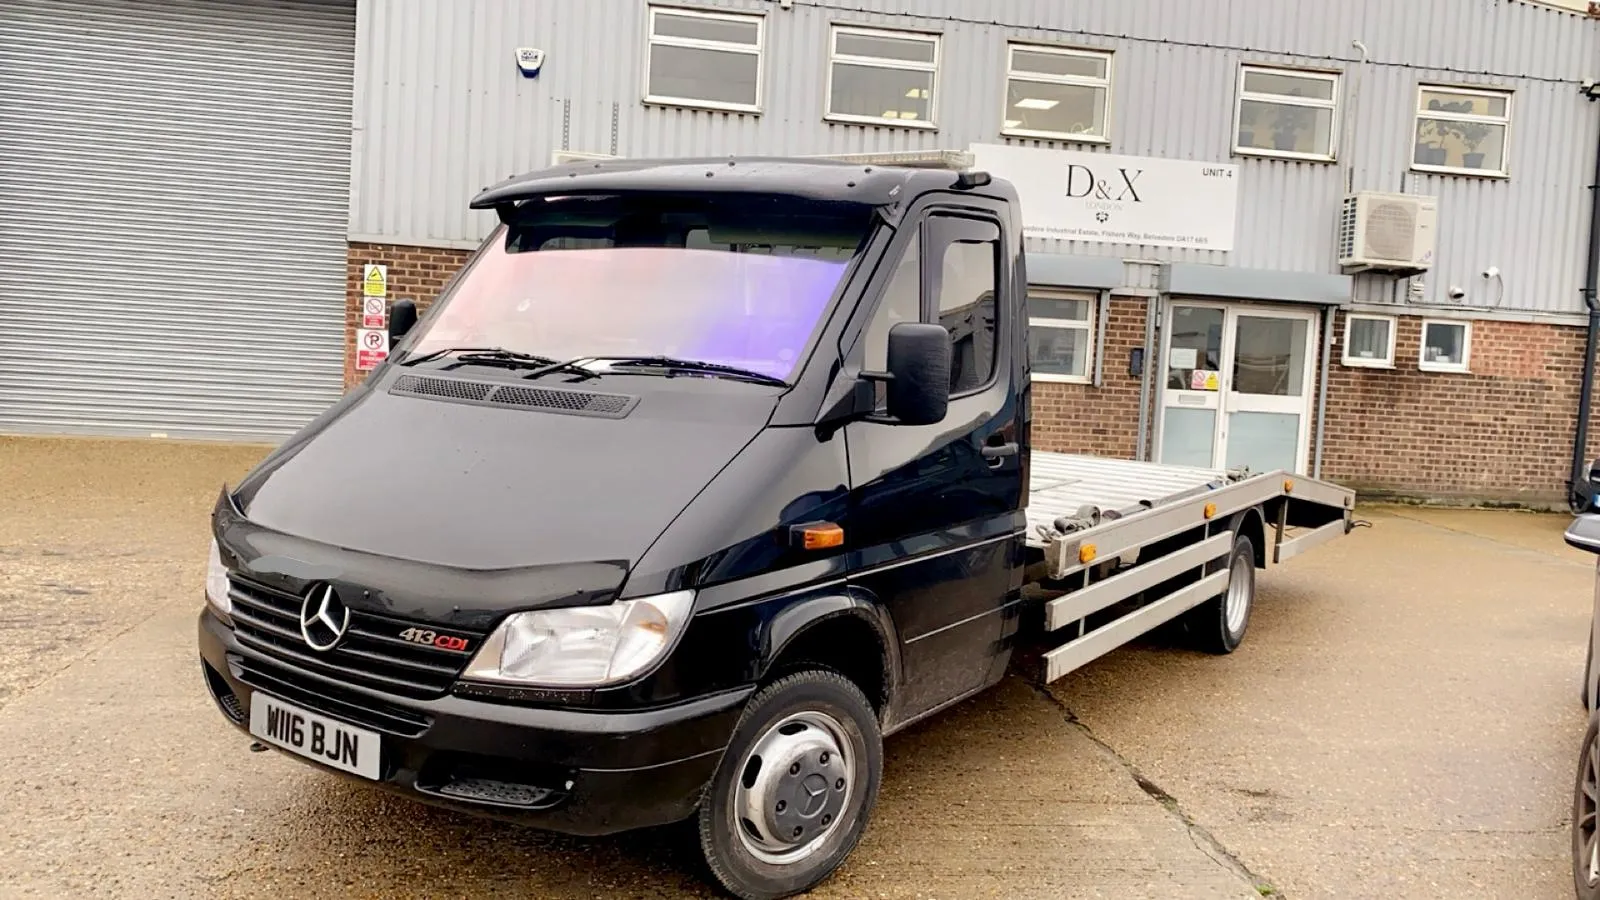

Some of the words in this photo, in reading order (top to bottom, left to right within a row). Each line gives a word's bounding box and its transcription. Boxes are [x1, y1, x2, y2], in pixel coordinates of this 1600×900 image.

[1066, 164, 1143, 202] D&X
[1202, 167, 1224, 178] UNIT
[1226, 169, 1233, 179] 4
[1046, 226, 1077, 234] Industrial
[311, 720, 359, 768] BJN
